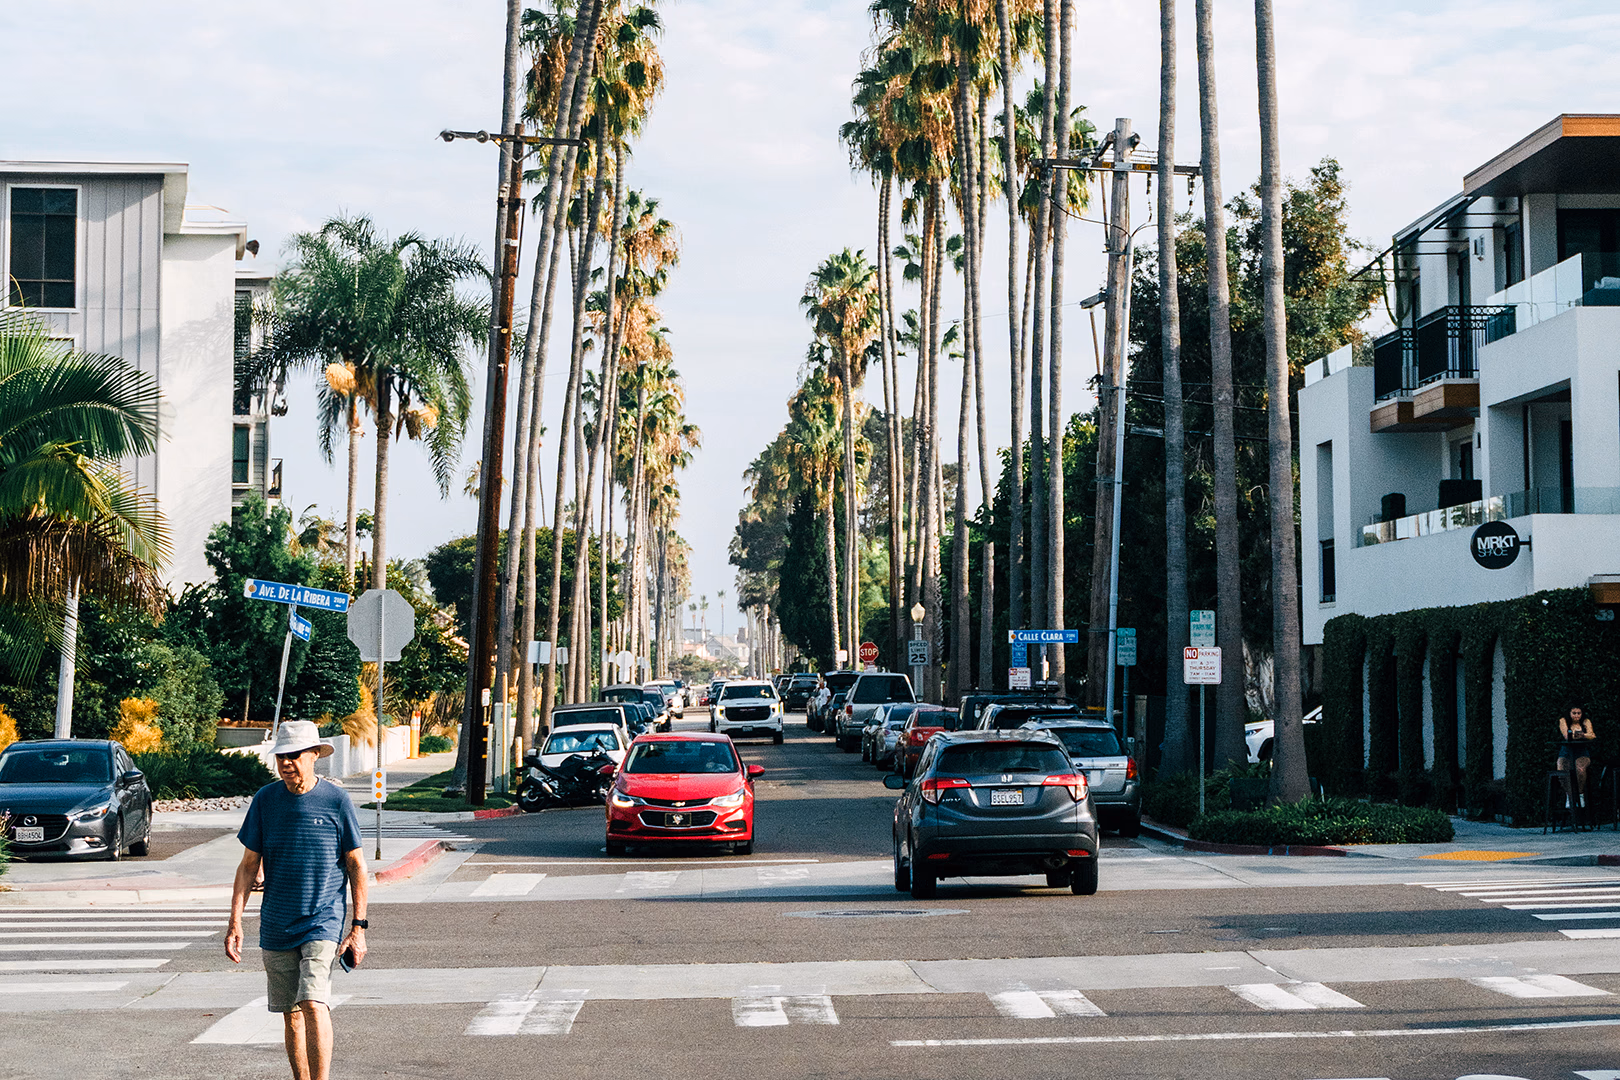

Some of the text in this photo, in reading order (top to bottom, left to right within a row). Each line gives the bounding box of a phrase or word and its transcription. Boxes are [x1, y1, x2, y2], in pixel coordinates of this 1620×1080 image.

[1477, 535, 1516, 549] MRKT
[860, 648, 878, 656] STOP
[1186, 649, 1198, 659] NO
[911, 653, 927, 663] 25
